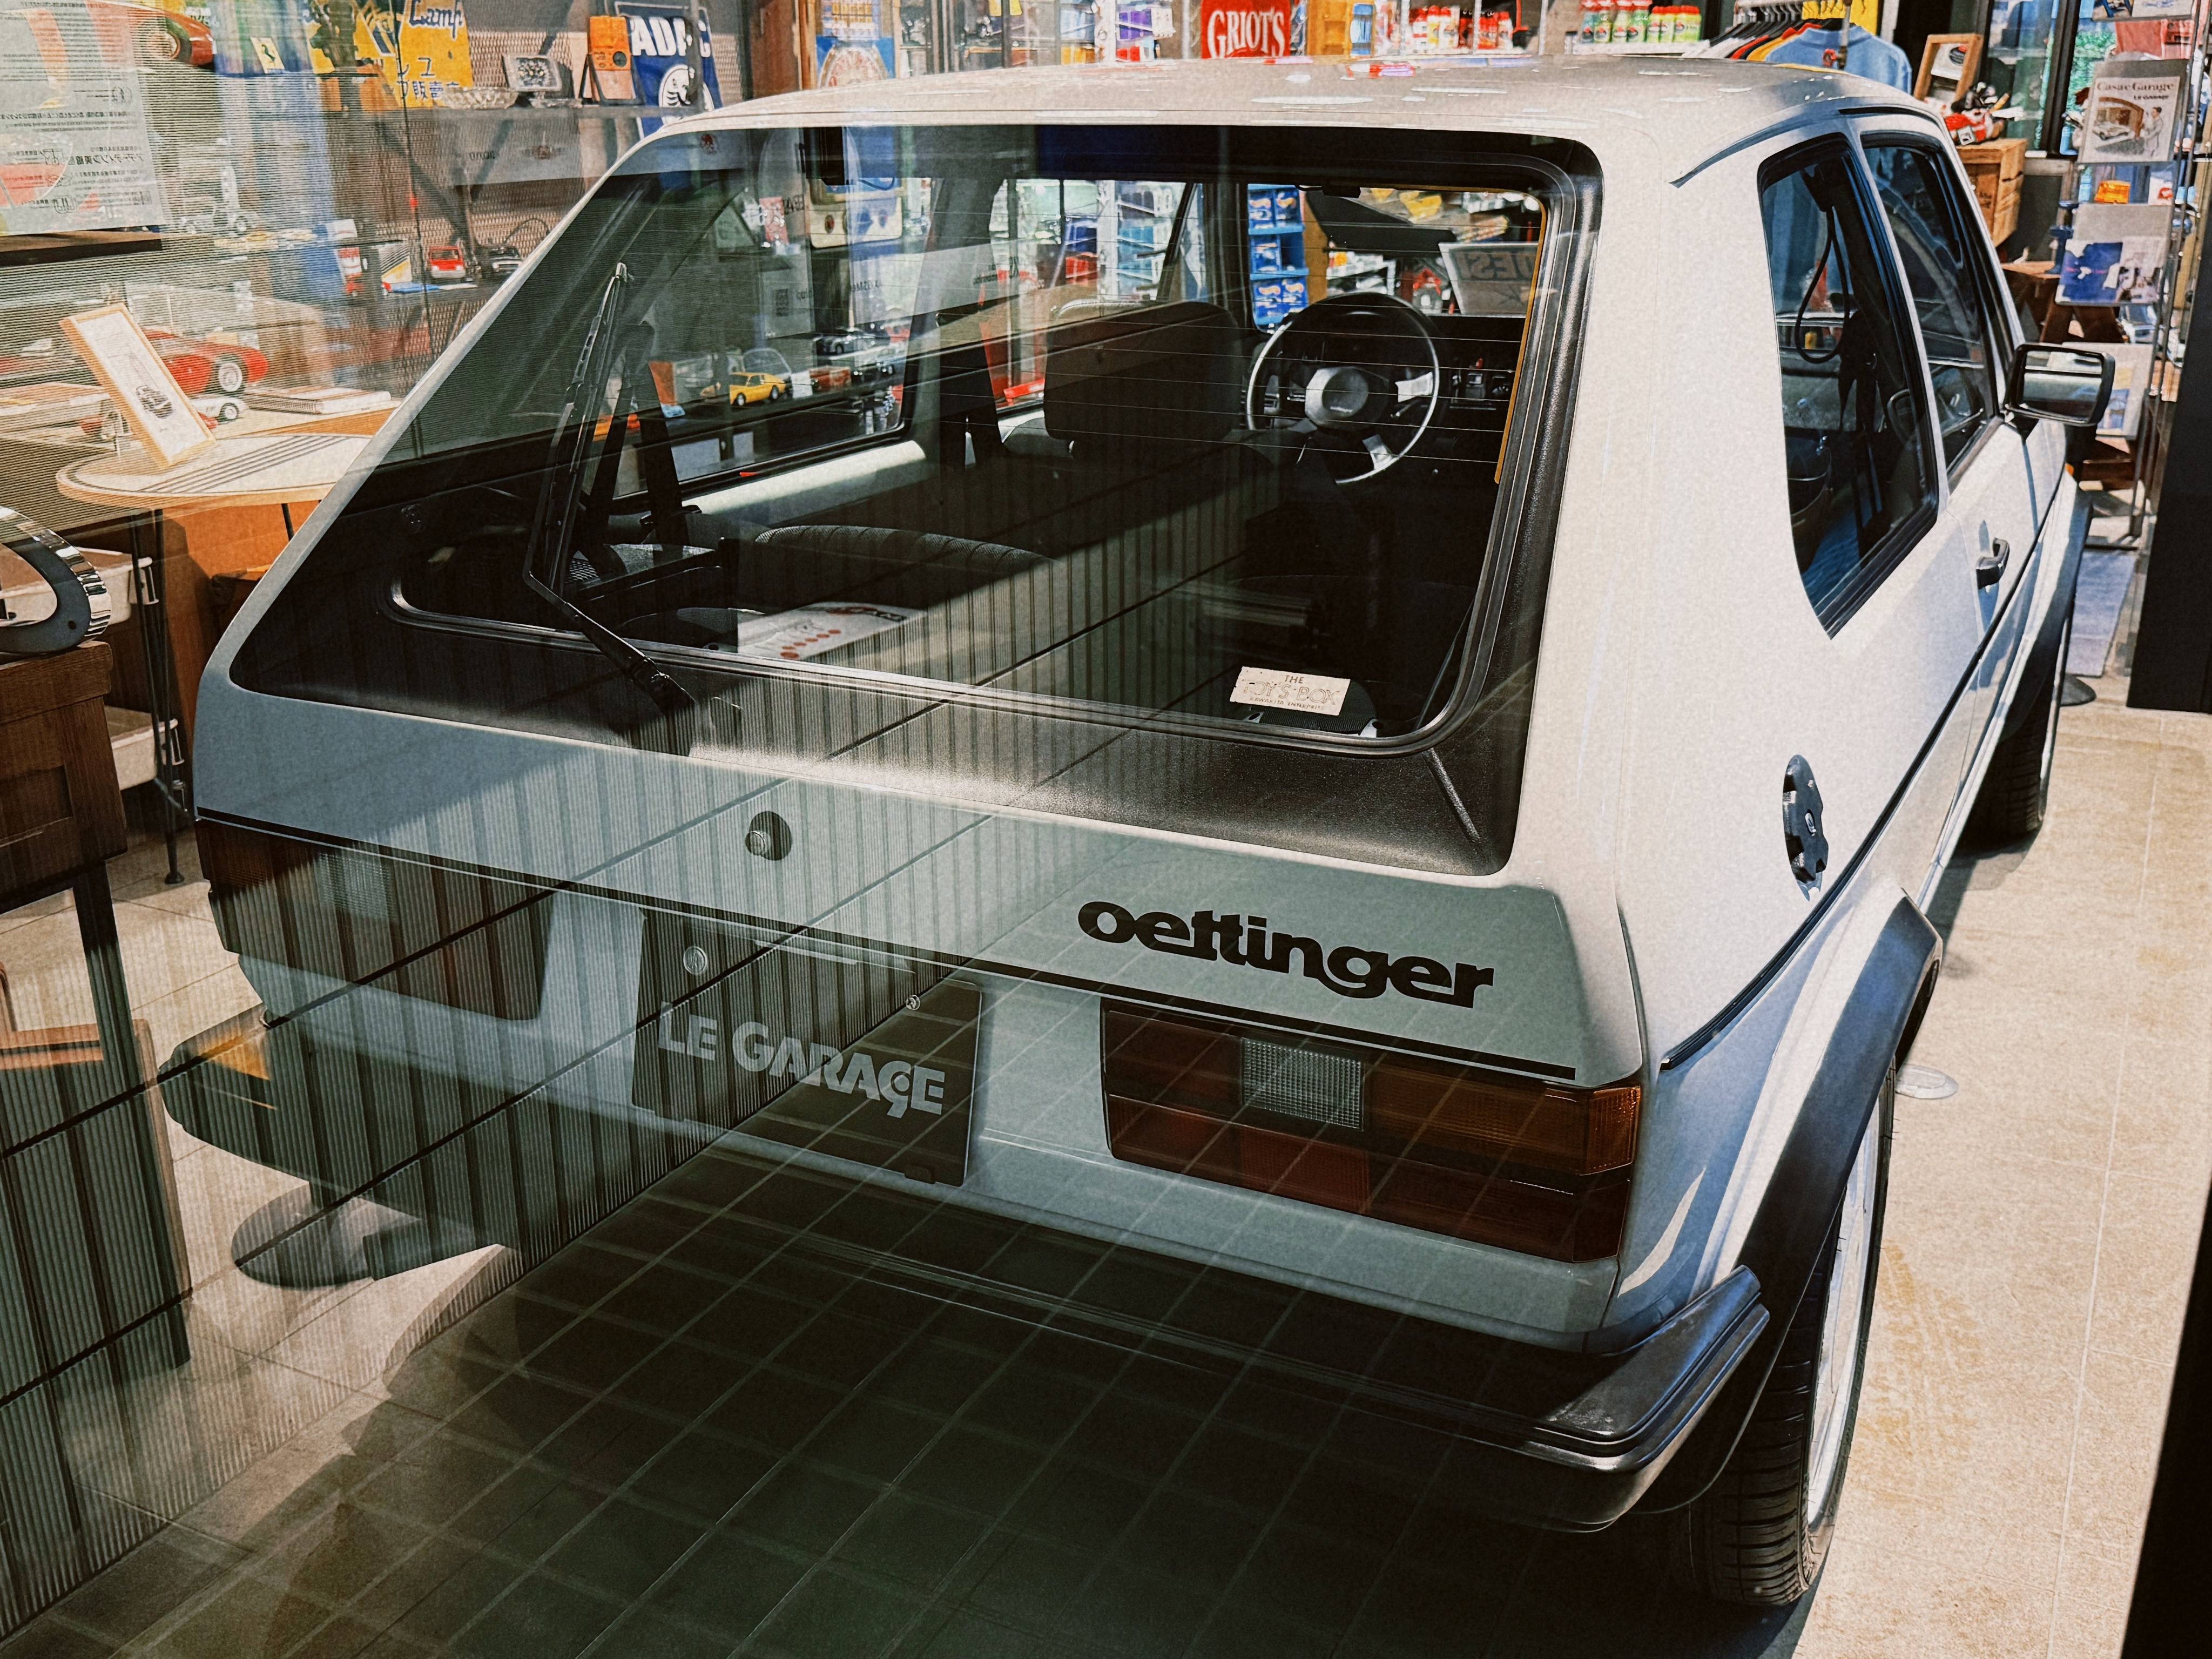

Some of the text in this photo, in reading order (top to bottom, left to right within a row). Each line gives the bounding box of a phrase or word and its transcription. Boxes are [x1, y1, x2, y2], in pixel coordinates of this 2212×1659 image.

[1207, 6, 1285, 58] GRIOT'S
[2132, 82, 2174, 93] Garage
[1242, 679, 1340, 705] TOY'S BOX
[1284, 675, 1305, 684] THE
[1078, 901, 1494, 1009] oettinger
[658, 1001, 946, 1119] LE GARAGE
